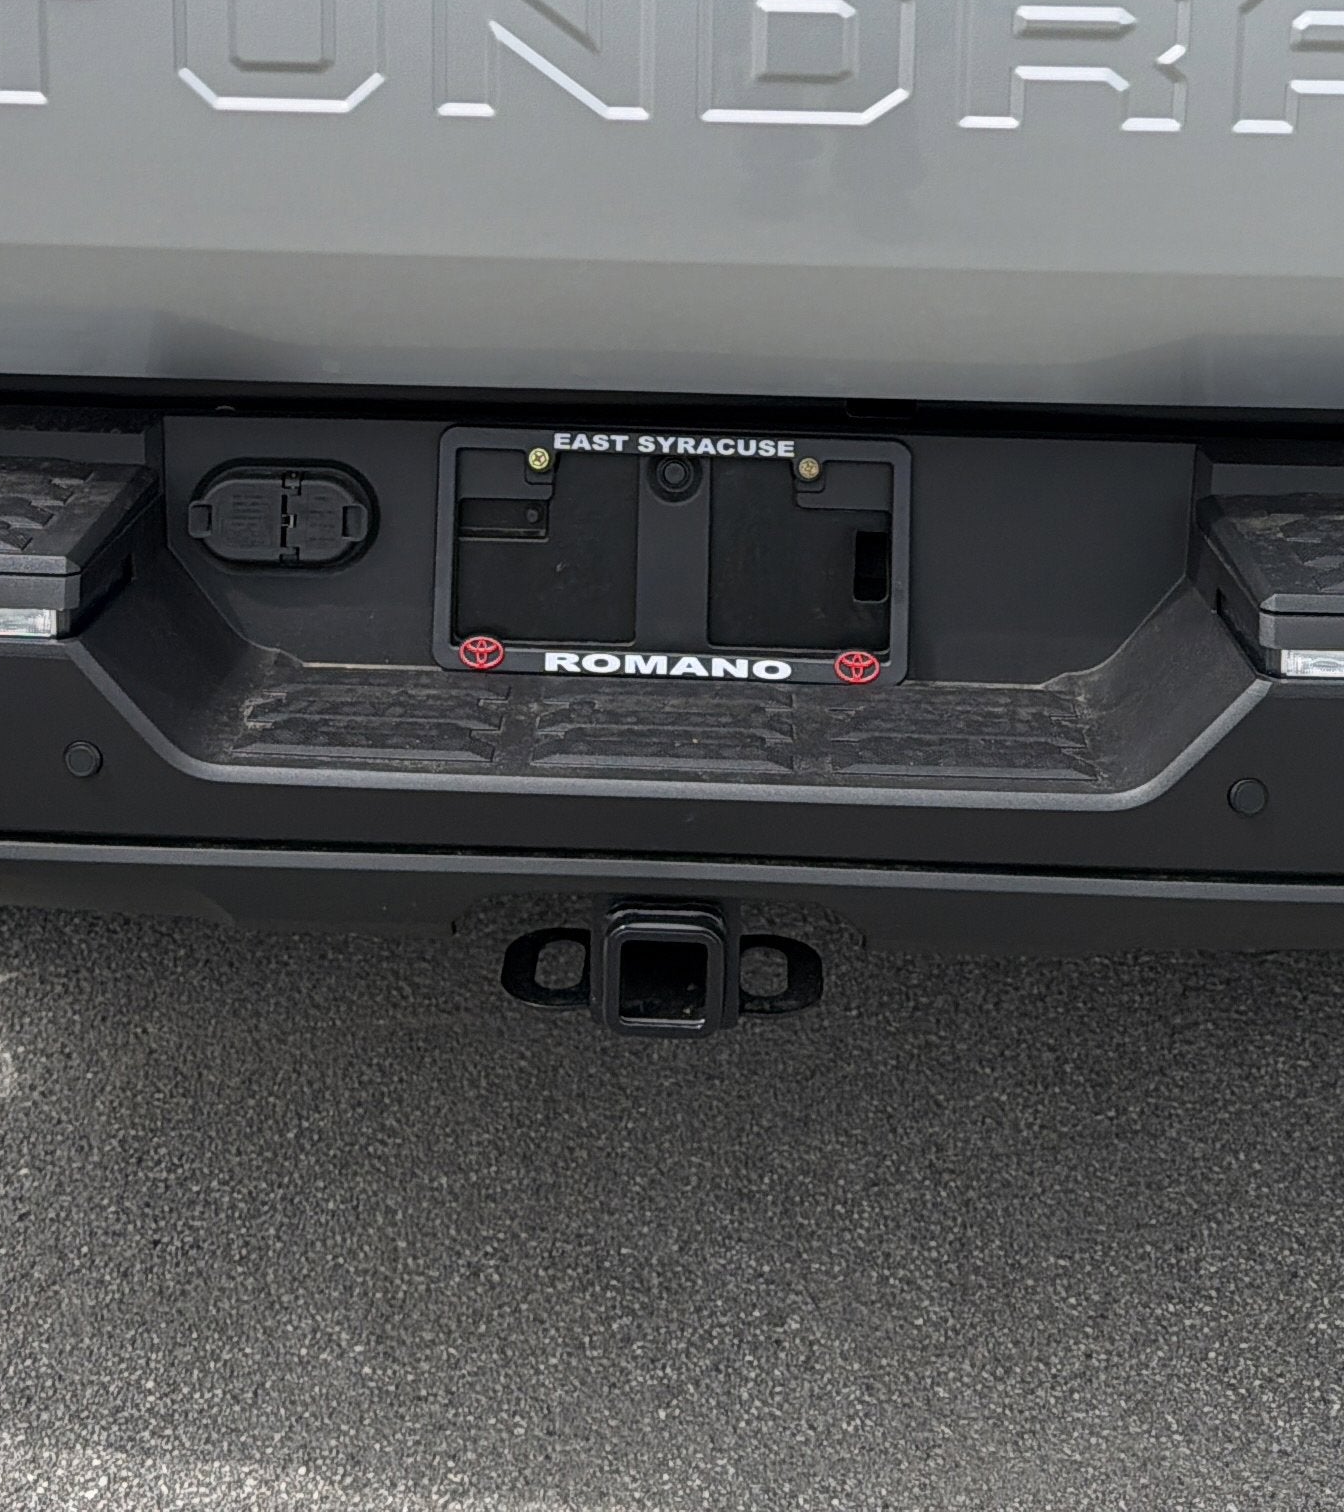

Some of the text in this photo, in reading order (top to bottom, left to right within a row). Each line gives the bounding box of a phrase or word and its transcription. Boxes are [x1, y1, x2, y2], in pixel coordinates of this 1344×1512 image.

[553, 432, 796, 457] EAST SYRACUSE
[544, 651, 792, 681] ROMANO
